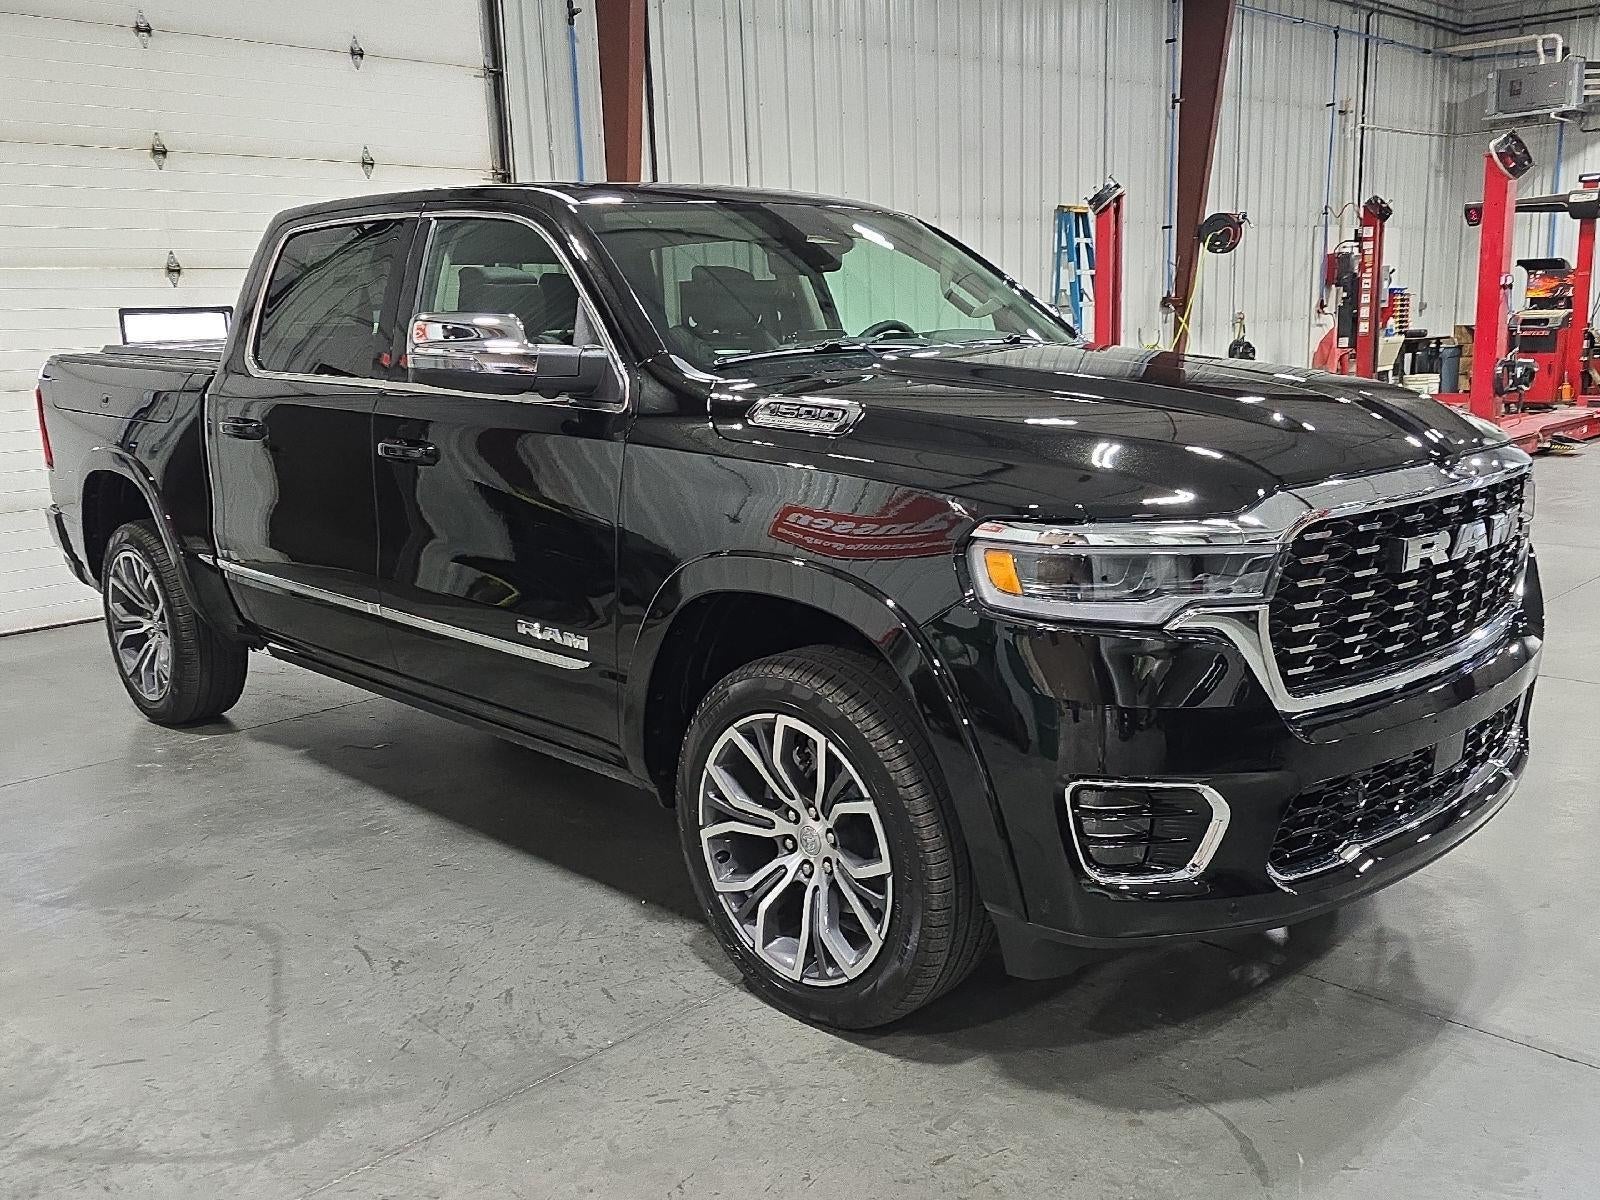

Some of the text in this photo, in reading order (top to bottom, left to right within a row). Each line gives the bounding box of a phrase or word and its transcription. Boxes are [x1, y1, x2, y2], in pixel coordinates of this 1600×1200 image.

[766, 402, 843, 422] 1500
[1402, 504, 1521, 573] RAM
[516, 619, 589, 652] RAM
